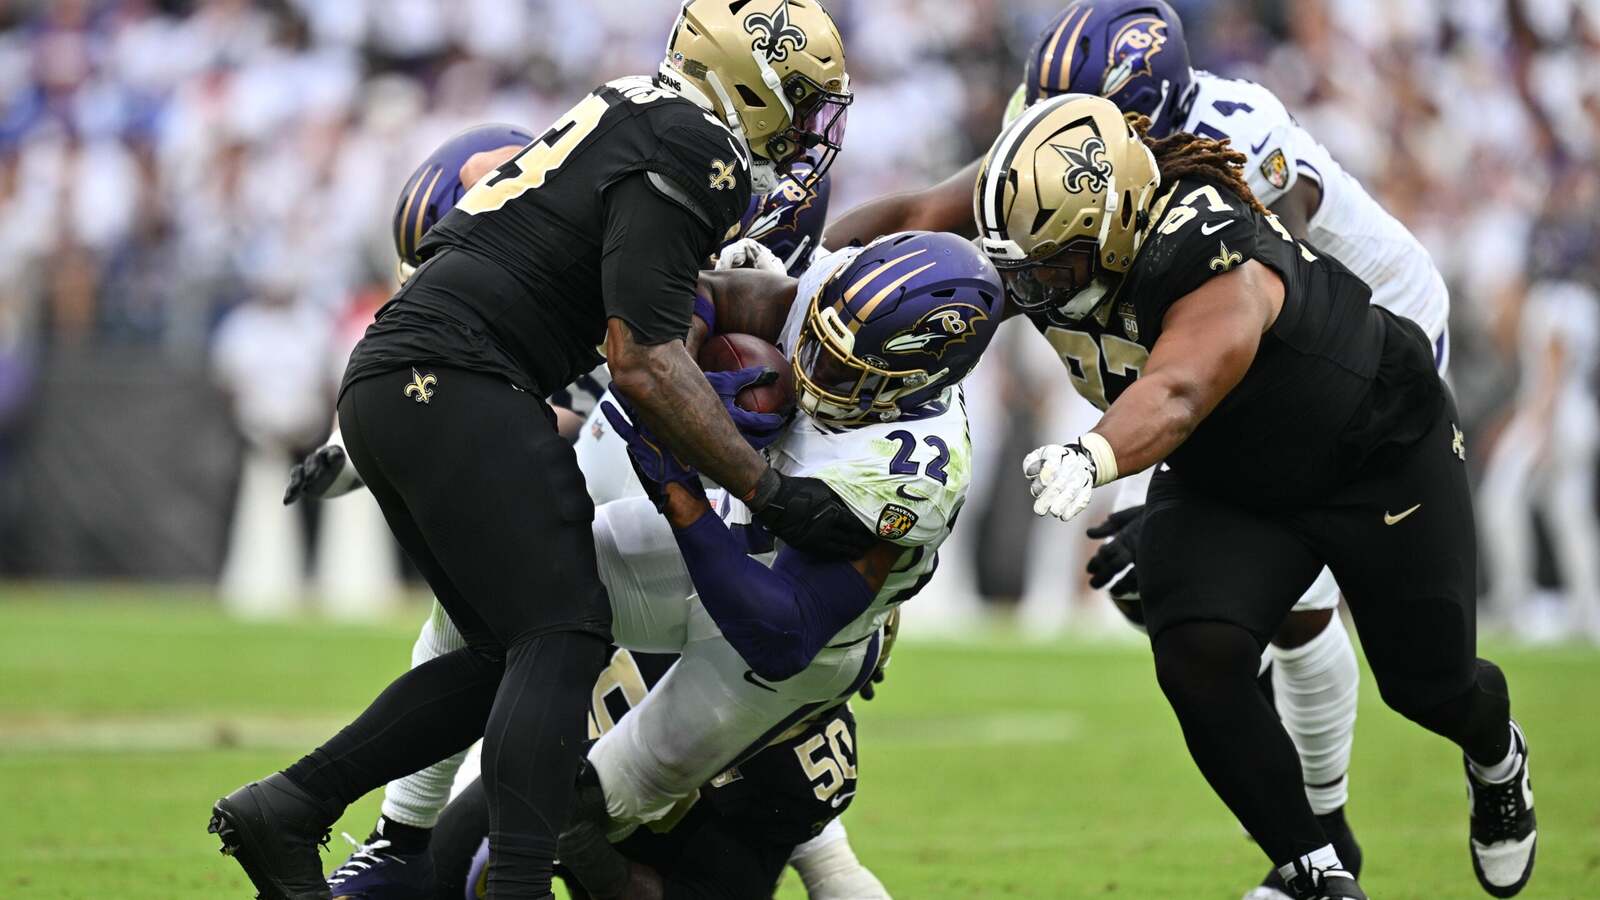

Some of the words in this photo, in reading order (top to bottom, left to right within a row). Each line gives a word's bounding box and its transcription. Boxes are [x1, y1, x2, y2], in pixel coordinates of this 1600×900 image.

[884, 429, 950, 486] 22
[889, 505, 916, 521] RAVENS
[793, 718, 858, 802] 50
